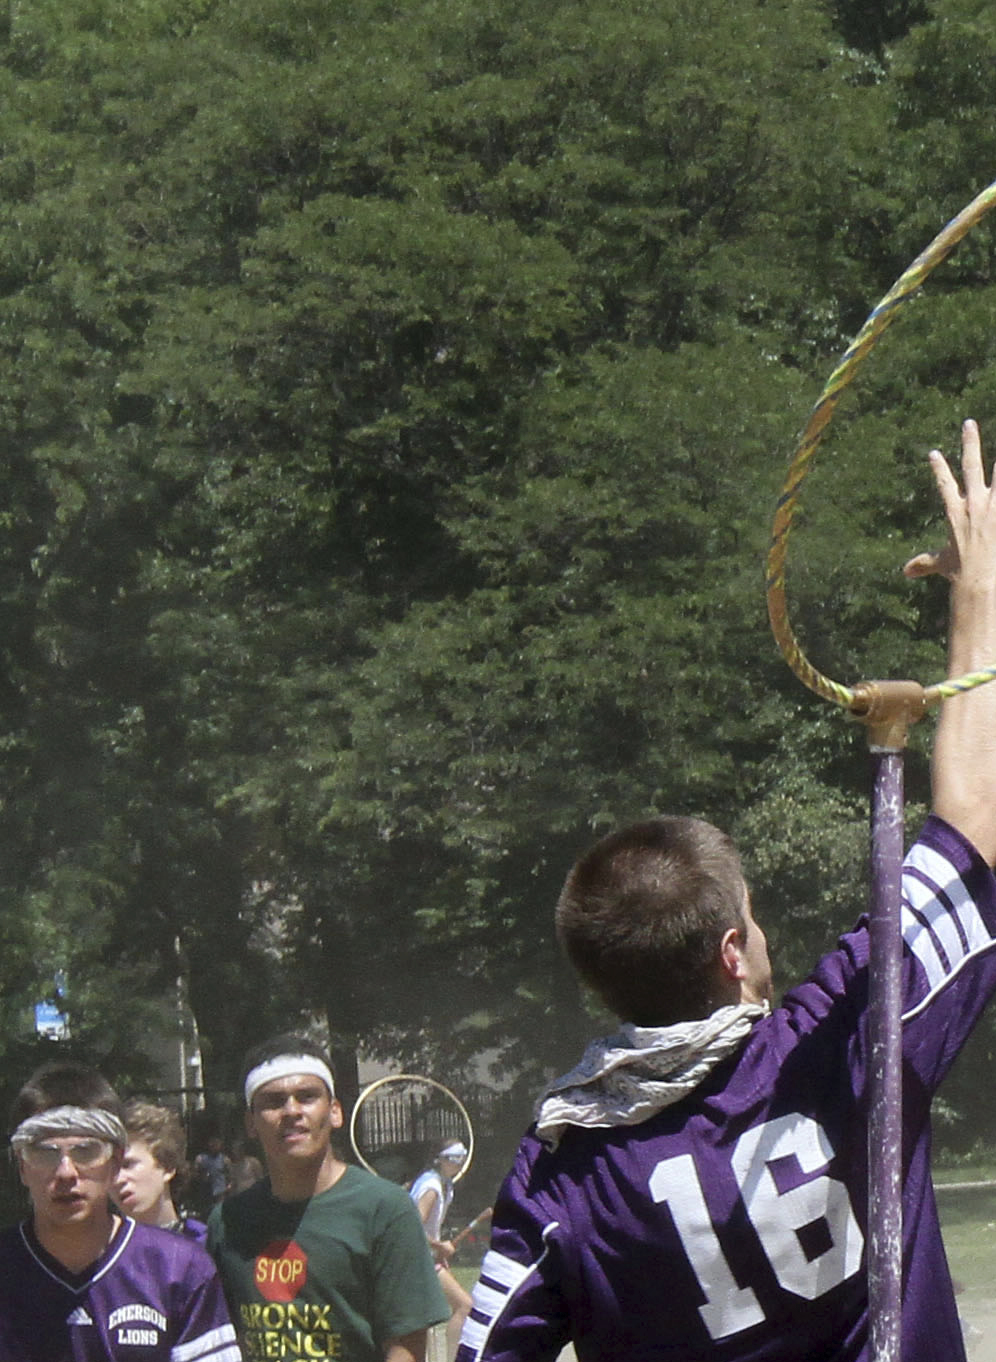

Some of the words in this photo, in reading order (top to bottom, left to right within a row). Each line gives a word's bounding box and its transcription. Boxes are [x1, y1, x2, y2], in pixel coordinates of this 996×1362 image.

[648, 1111, 865, 1340] 16
[256, 1257, 304, 1284] STOP
[108, 1303, 167, 1332] EMERSON
[118, 1329, 158, 1346] LIONS
